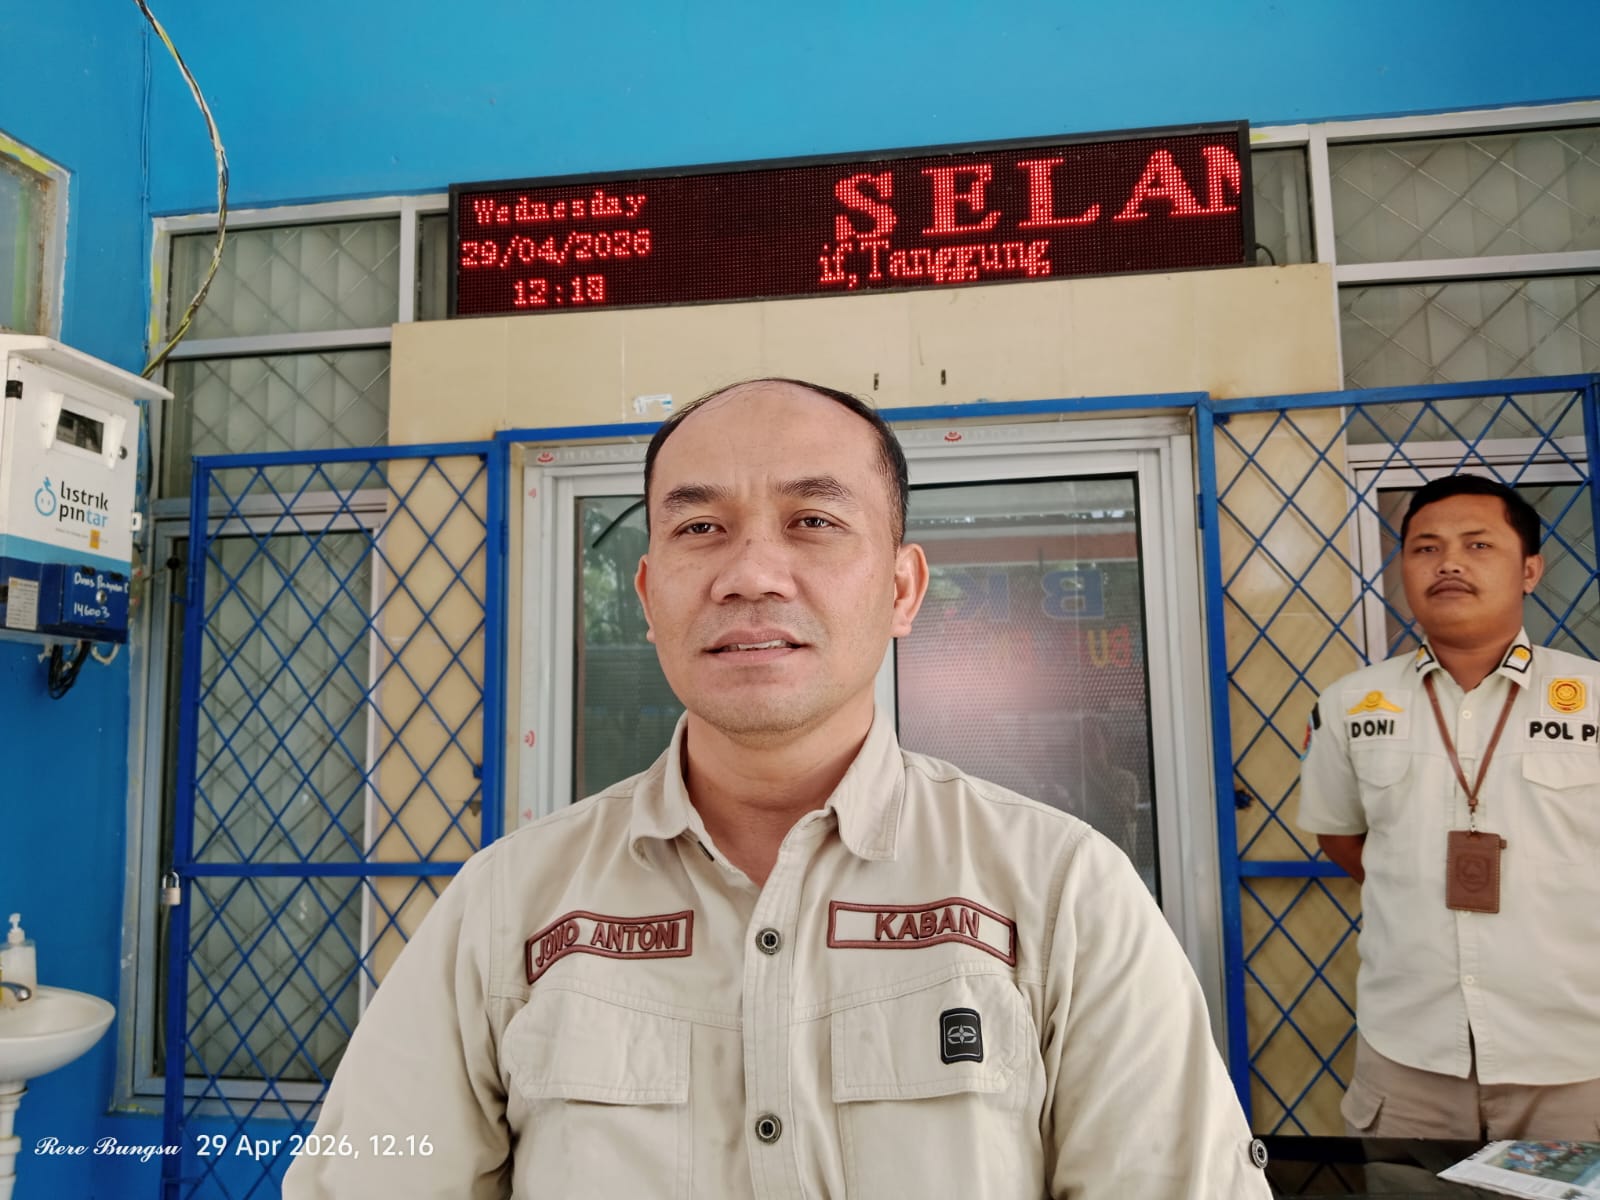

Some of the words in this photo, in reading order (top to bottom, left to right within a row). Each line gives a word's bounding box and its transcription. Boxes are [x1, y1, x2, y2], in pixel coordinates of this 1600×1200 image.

[473, 190, 647, 225] Wednesday
[460, 229, 651, 269] 29/04/2026
[60, 480, 108, 511] listrik
[59, 503, 108, 527] pintar
[1350, 719, 1394, 739] DONI
[1529, 721, 1574, 740] POL
[874, 906, 980, 940] KABAN
[535, 919, 580, 968] JONO
[590, 920, 680, 952] ANTONI
